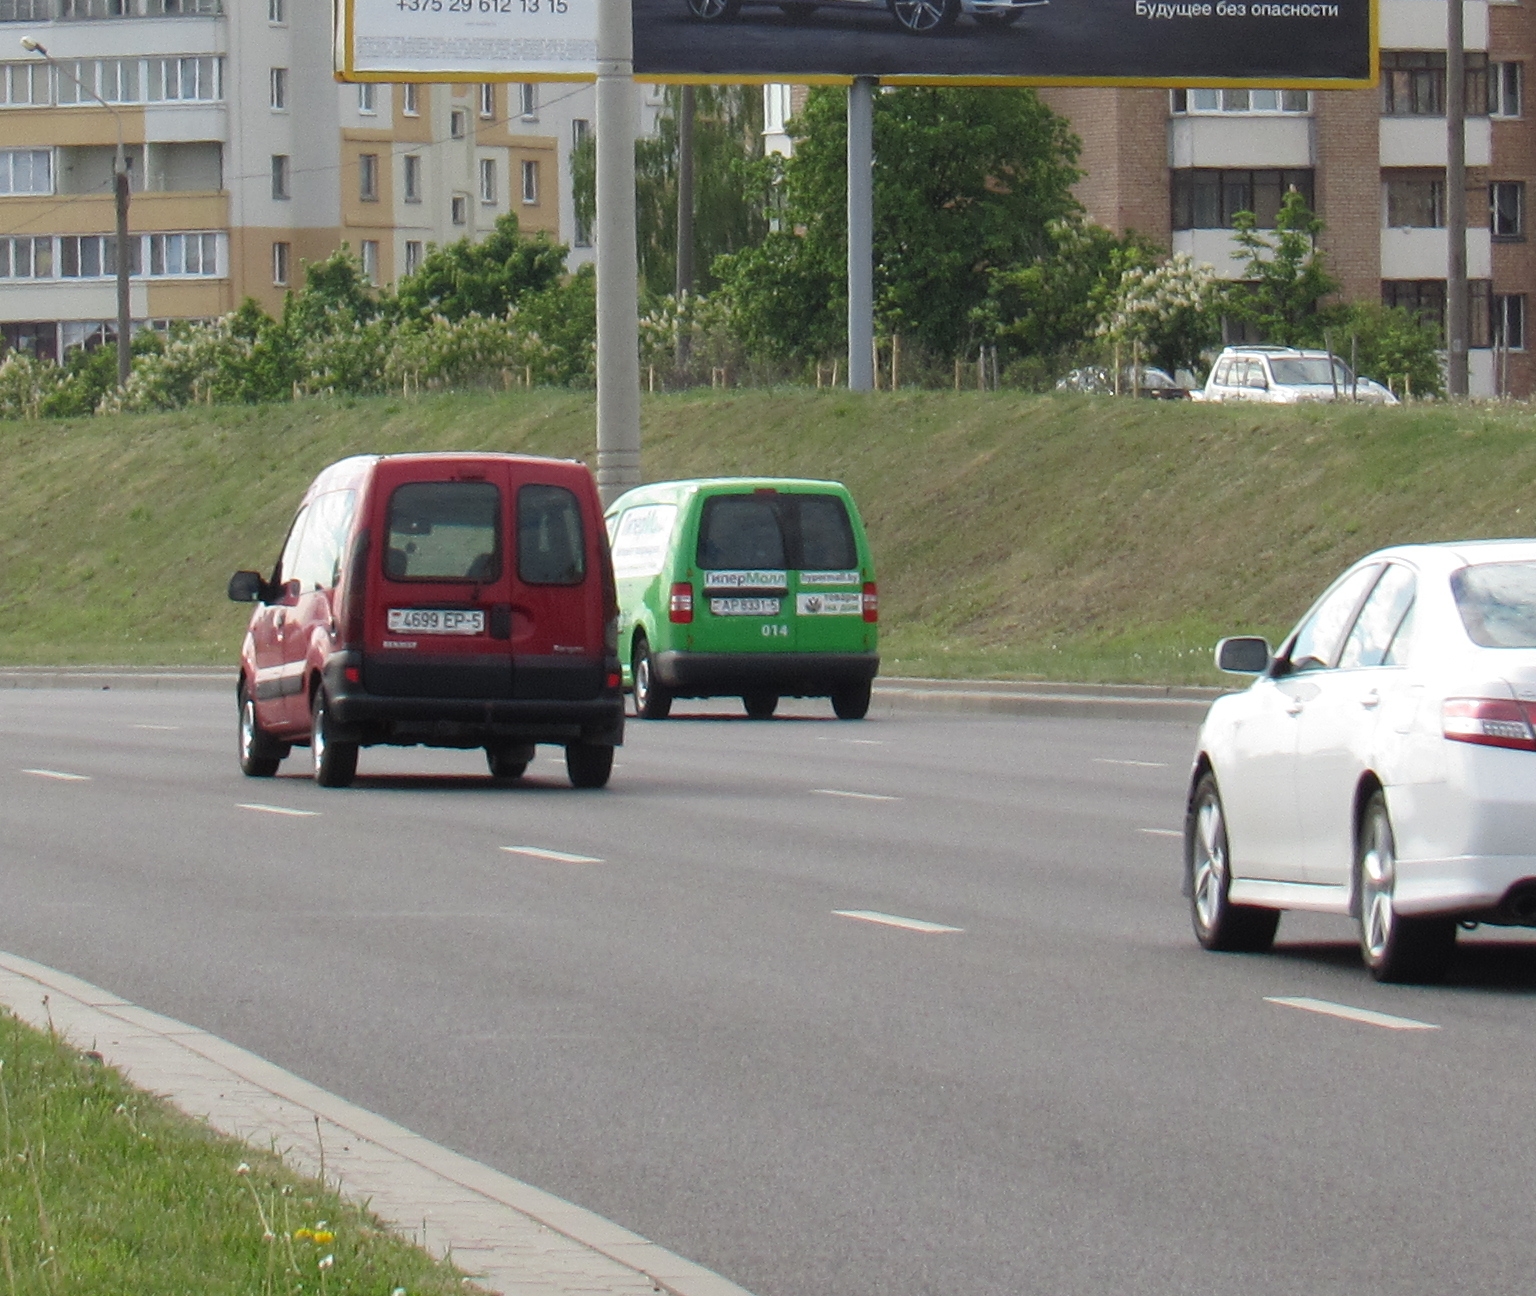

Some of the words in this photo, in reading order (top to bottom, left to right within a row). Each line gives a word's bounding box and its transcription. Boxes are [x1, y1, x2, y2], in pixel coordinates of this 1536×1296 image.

[1135, 0, 1212, 19] Будущее
[1216, 0, 1246, 17] без
[1251, 3, 1339, 18] опасности
[705, 571, 785, 587] ГиперМолл
[722, 599, 739, 611] AP
[403, 611, 439, 628] 4699
[443, 612, 482, 629] EP-5
[761, 624, 789, 637] 014
